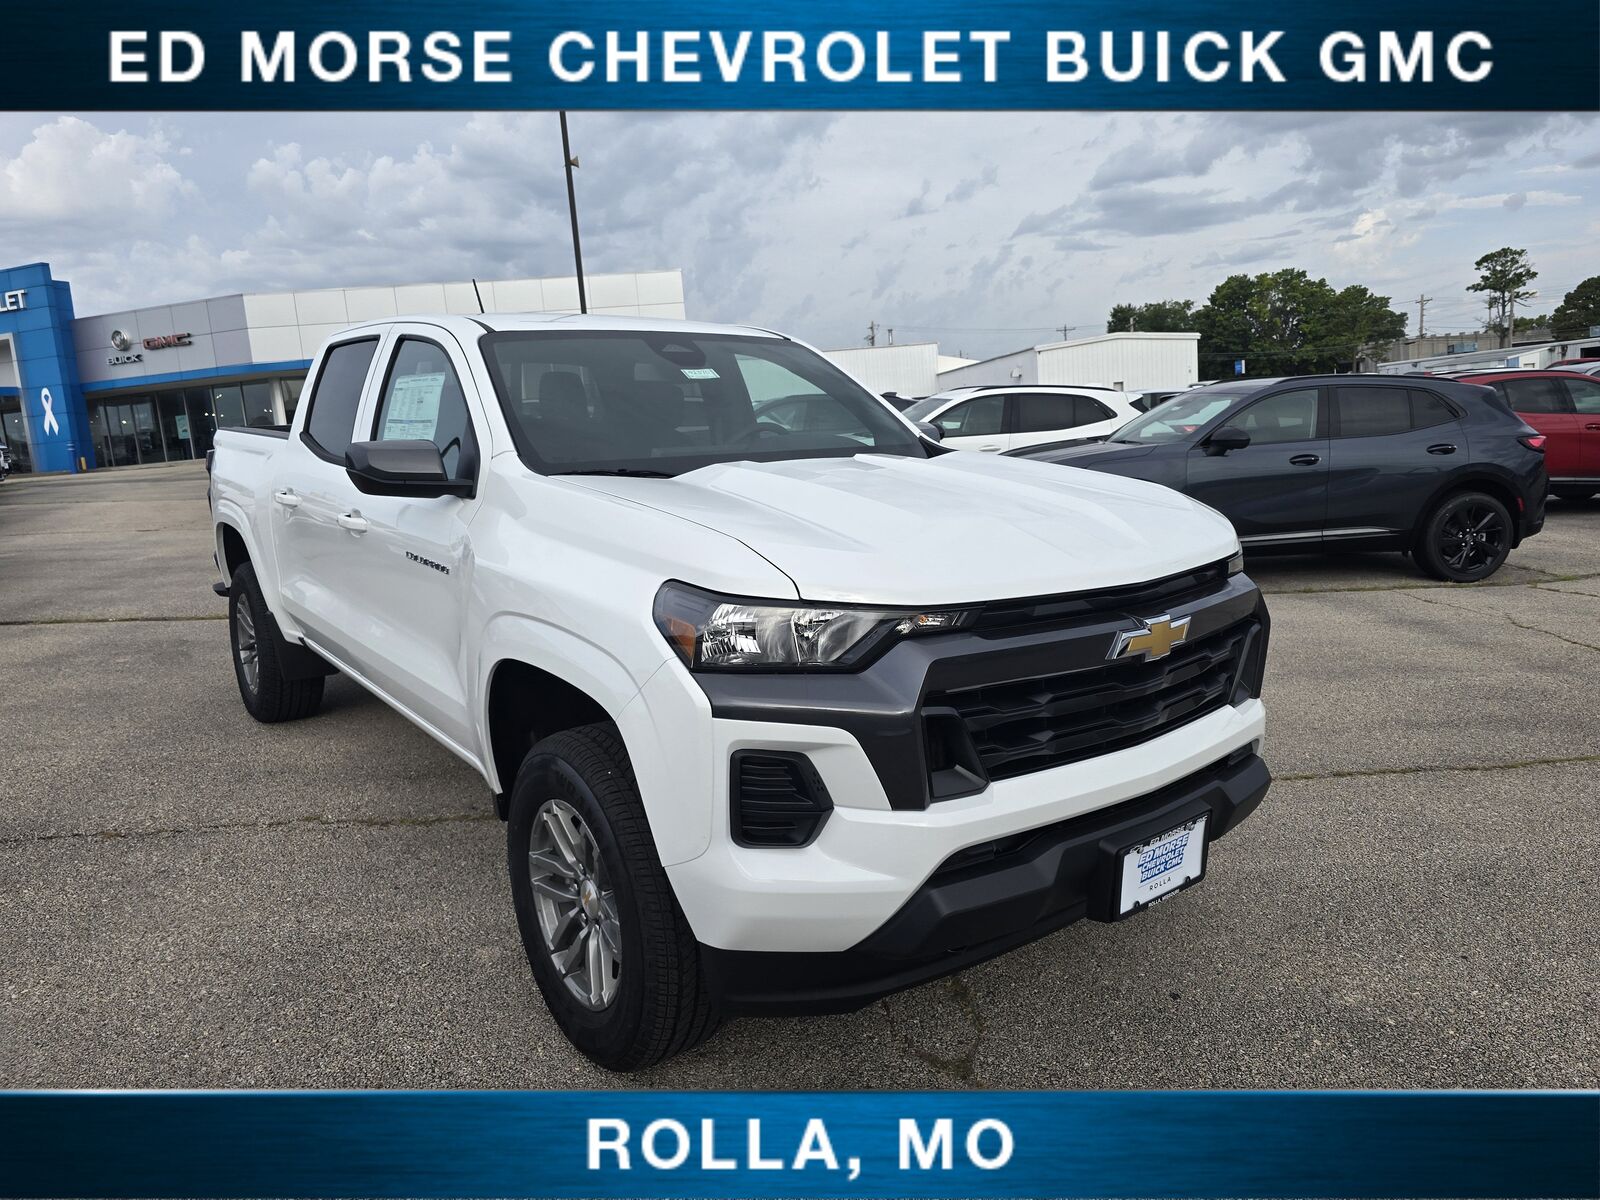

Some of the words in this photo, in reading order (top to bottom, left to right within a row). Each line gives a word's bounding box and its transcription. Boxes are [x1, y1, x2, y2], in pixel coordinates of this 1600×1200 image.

[143, 333, 192, 350] GMC
[107, 354, 142, 365] BUICK
[1139, 849, 1154, 866] ED
[1153, 832, 1190, 859] MORSE
[1149, 876, 1172, 891] ROLLA
